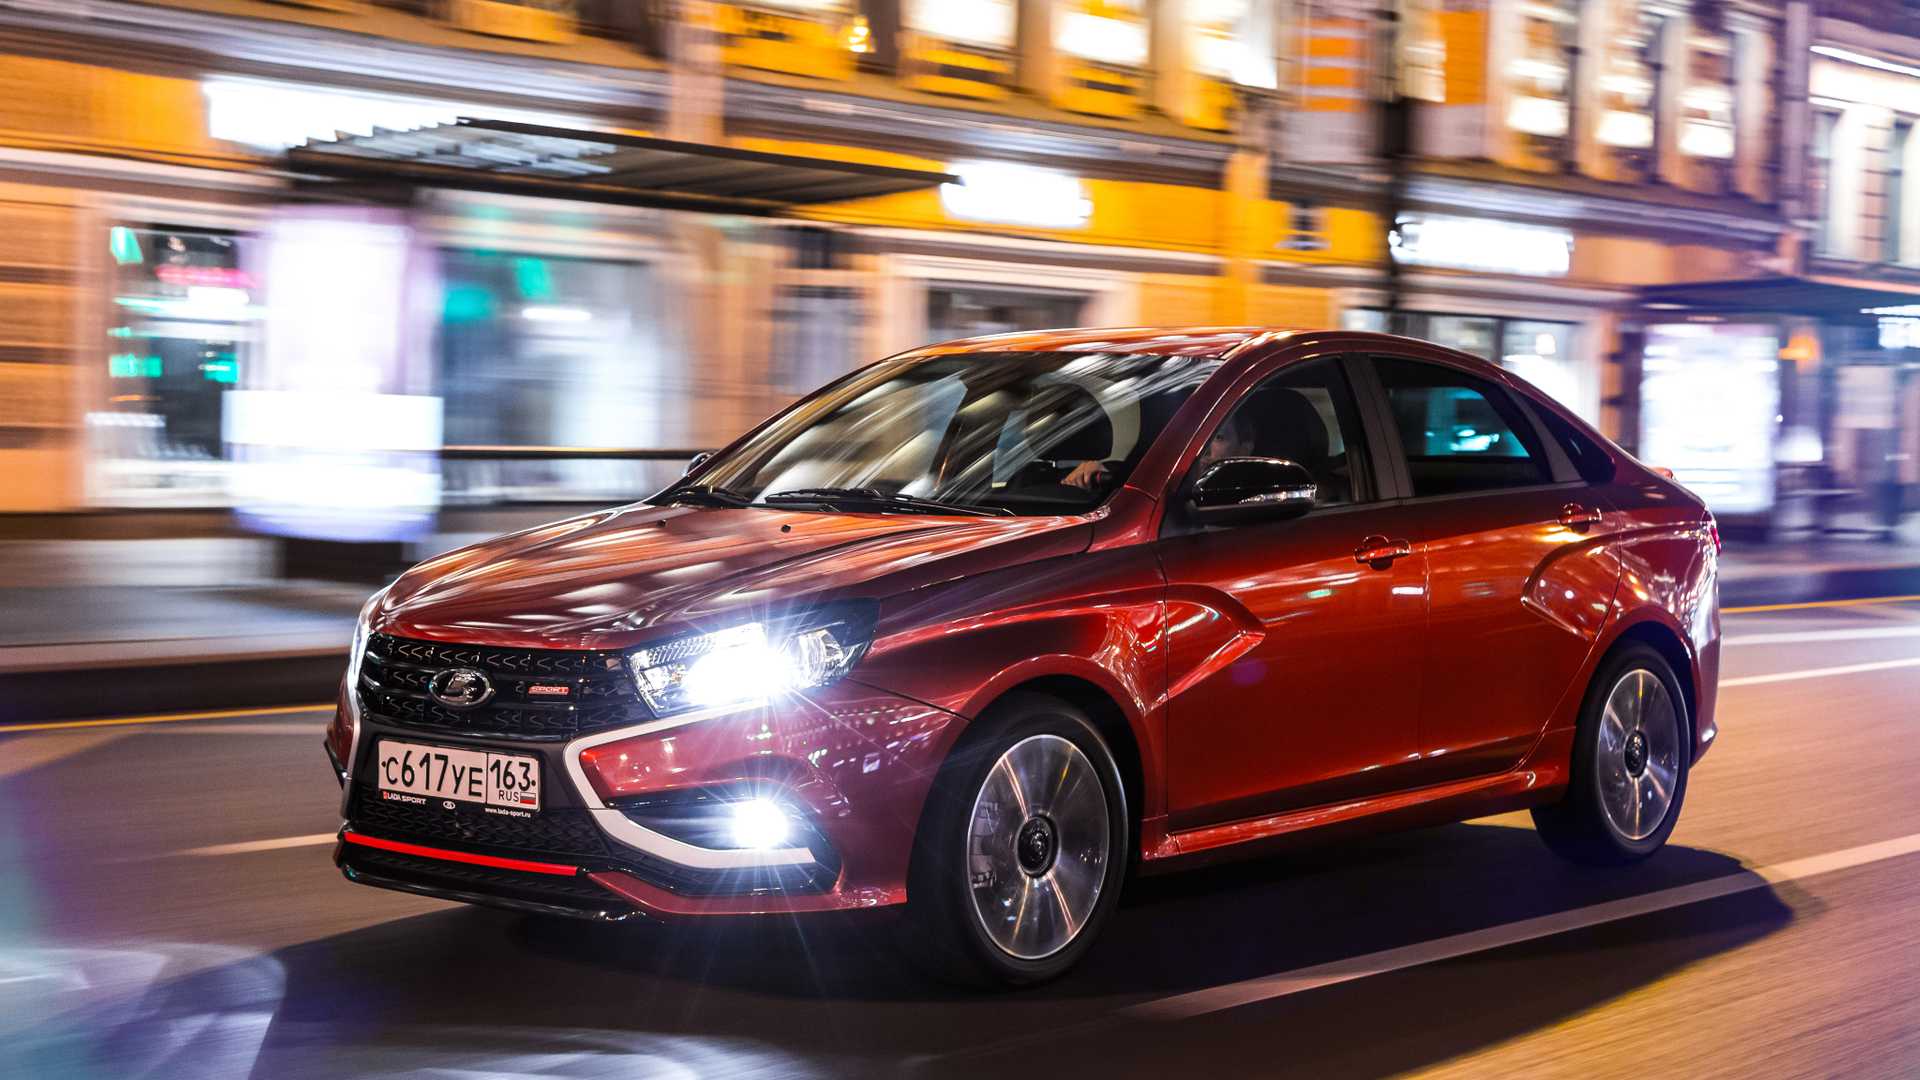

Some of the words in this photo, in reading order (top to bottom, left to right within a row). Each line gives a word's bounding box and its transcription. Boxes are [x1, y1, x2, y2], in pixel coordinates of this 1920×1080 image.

[528, 686, 569, 695] SPORT
[490, 759, 530, 791] 163
[402, 795, 426, 805] SPORT
[499, 790, 519, 802] RUS
[485, 807, 531, 818] www.lada-sport.ru
